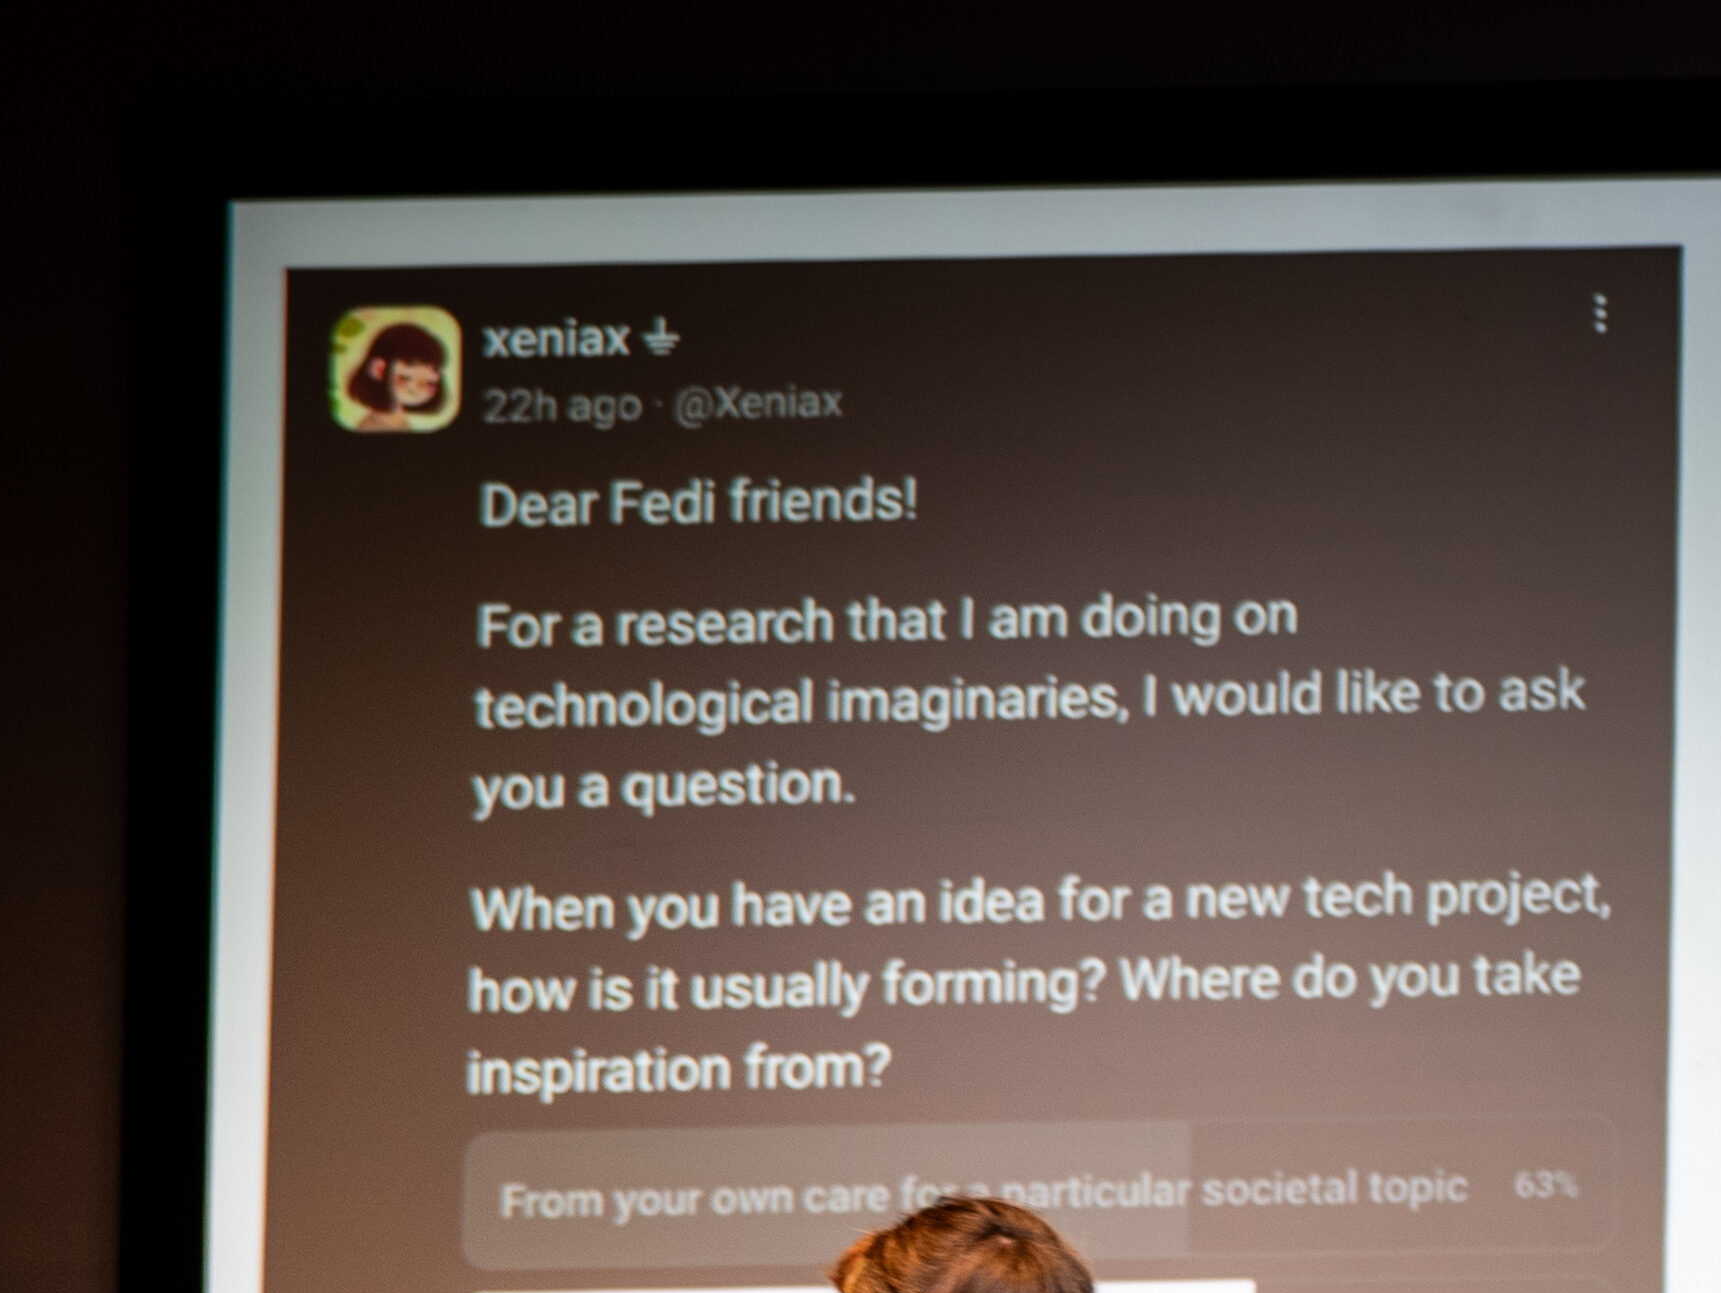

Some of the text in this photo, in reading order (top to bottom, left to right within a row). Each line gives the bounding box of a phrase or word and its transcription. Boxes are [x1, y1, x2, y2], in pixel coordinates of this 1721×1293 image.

[483, 317, 631, 358] xeniax
[482, 384, 844, 430] 22h ago @Xeniax
[480, 475, 919, 528] Dear Fedi friends!
[477, 591, 1299, 648] For a research that I am doing on
[474, 665, 1587, 737] technological imaginaries, I would like to ask
[471, 760, 856, 822] you a question.
[469, 869, 1612, 941] When you have an idea for a new tech project,
[467, 949, 1582, 1019] how is it usually forming? Where do you take
[466, 1041, 893, 1104] inspiration from?
[499, 1182, 604, 1220] From
[613, 1186, 702, 1226] your
[710, 1184, 794, 1219] own
[803, 1182, 891, 1216] care
[999, 1170, 1191, 1211] particular
[1202, 1168, 1359, 1207] societal
[1368, 1166, 1470, 1211] topic
[1513, 1169, 1581, 1200] 63%
